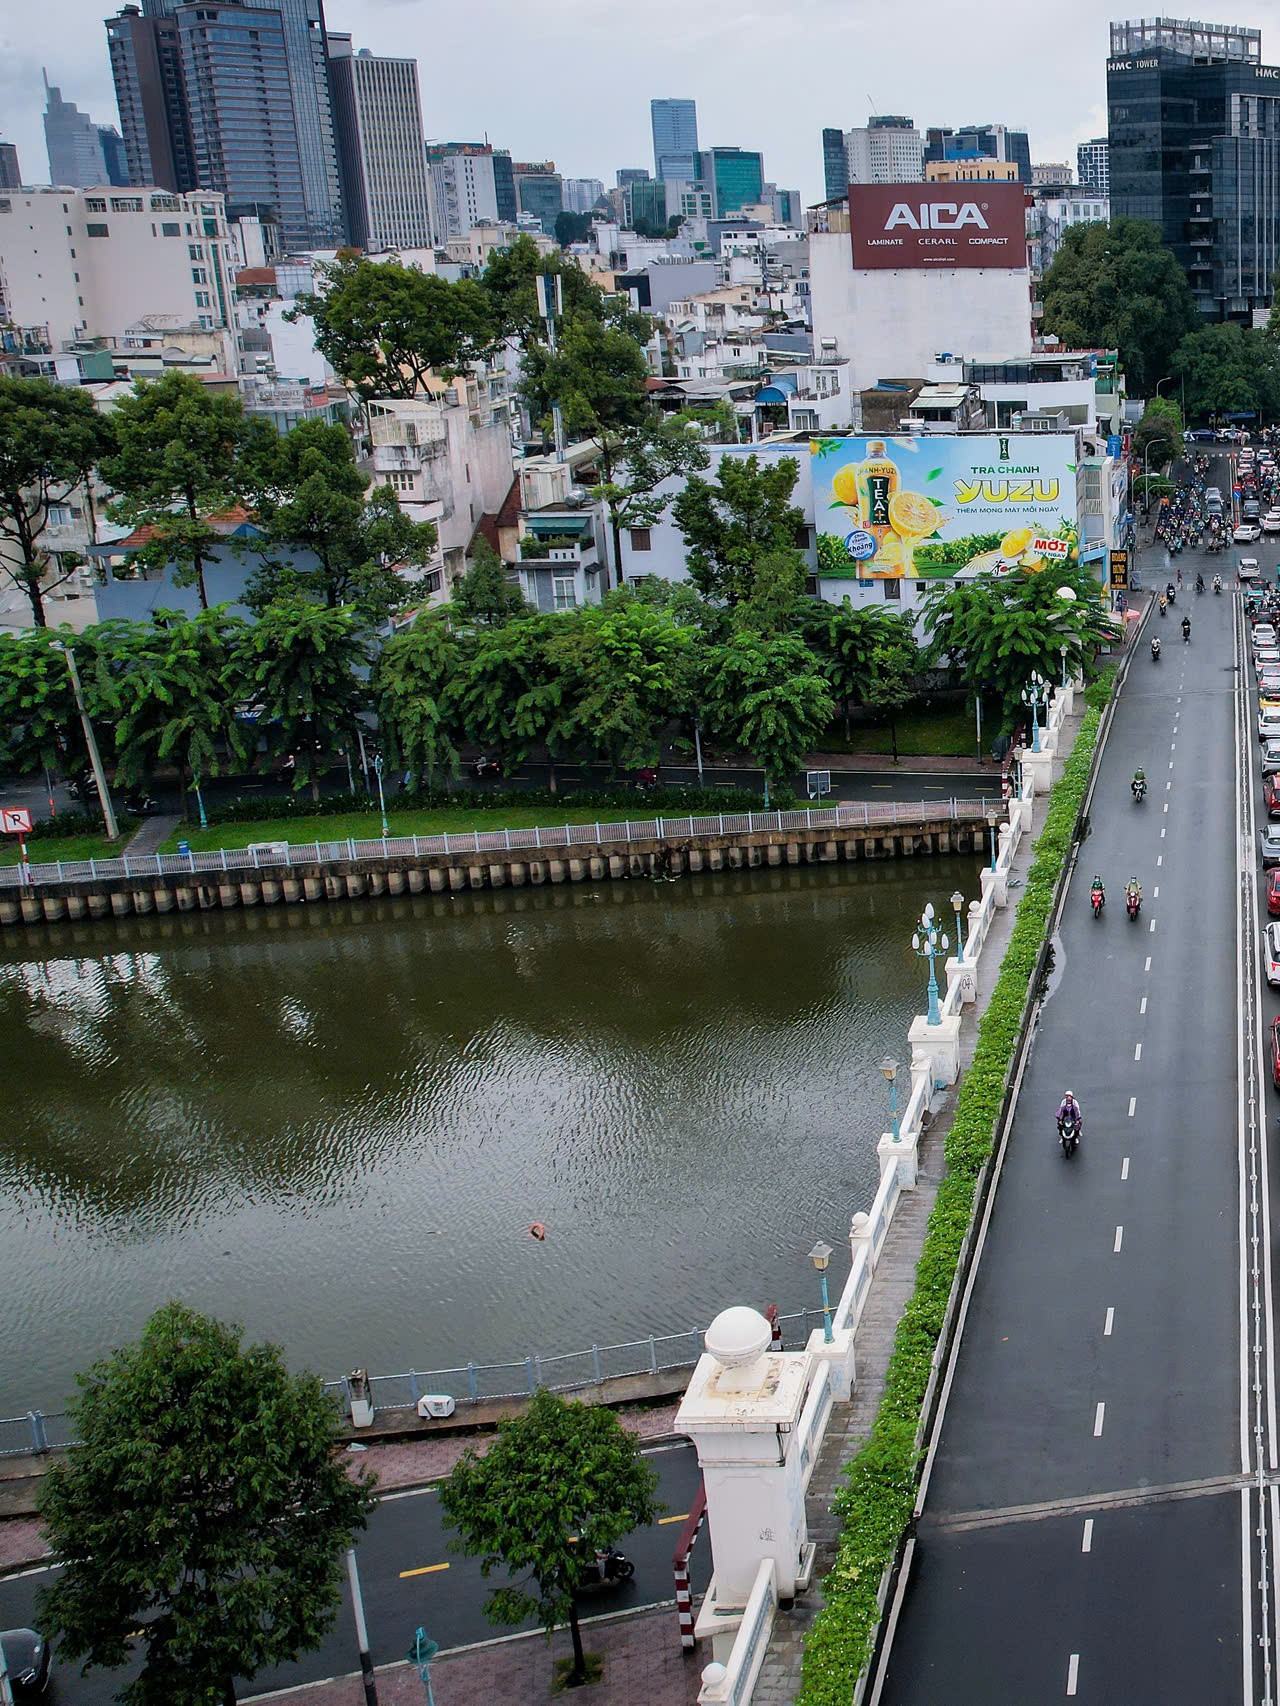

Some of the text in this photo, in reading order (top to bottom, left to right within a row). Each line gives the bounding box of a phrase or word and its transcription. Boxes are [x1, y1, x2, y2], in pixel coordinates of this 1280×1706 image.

[1107, 59, 1159, 71] HMC TOWER
[1255, 68, 1279, 79] HMC
[867, 238, 904, 246] LAMINATE
[968, 237, 1009, 245] COMPACT
[997, 465, 1040, 474] CHANH
[953, 478, 1059, 504] YUZU
[1034, 539, 1067, 553] MỚI
